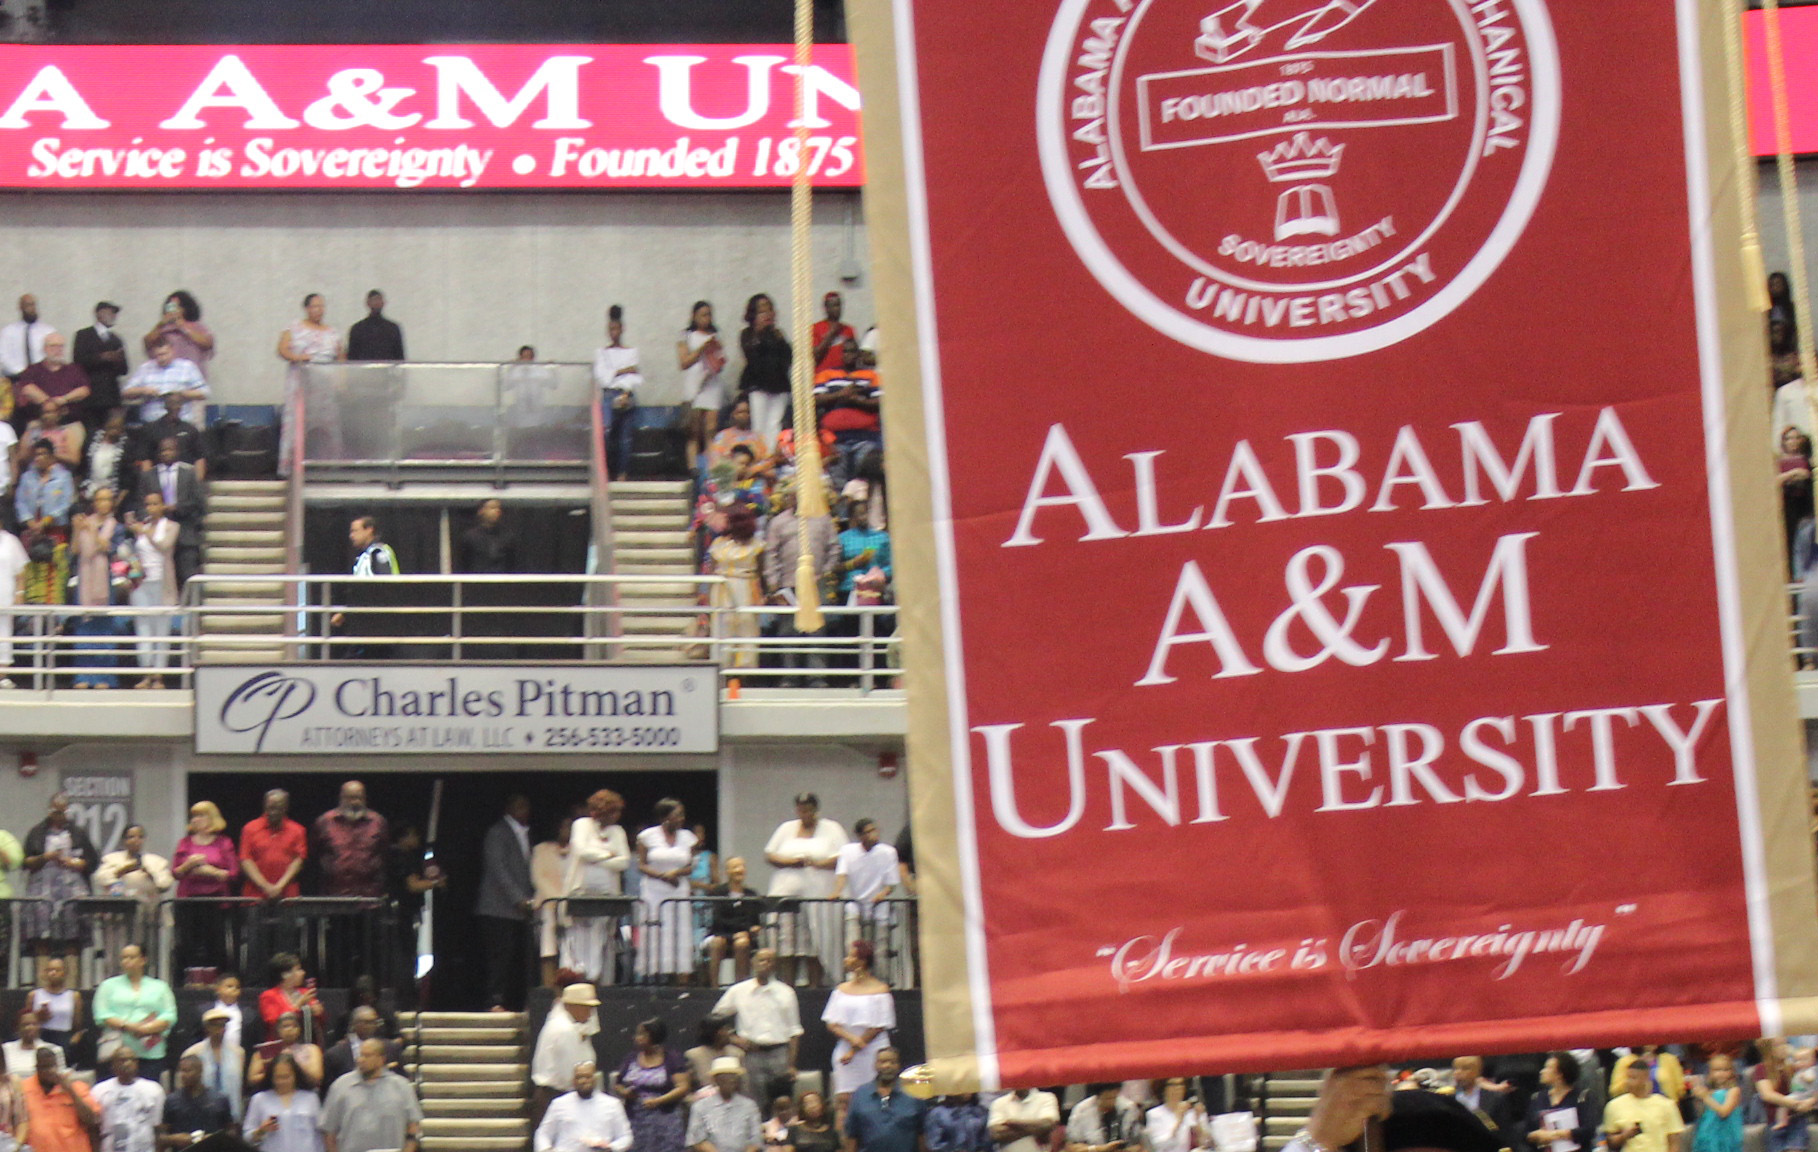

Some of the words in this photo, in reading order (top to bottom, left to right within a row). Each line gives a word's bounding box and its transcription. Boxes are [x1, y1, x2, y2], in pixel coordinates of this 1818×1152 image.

[158, 54, 594, 132] A&M
[1072, 16, 1127, 190] ALABAMA
[1160, 79, 1305, 124] FOUNDED
[1306, 72, 1436, 105] NORMAL
[1471, 0, 1526, 158] HANICAL
[27, 137, 187, 178] Service
[196, 137, 233, 177] is
[241, 137, 494, 188] Sovereignty
[548, 136, 740, 178] Founded
[752, 136, 857, 178] 1875
[1216, 215, 1398, 268] SOVEREIGNTY
[1184, 251, 1439, 328] UNIVERSITY
[1001, 406, 1661, 548] ALABAMA
[1133, 531, 1550, 687] A&M
[335, 678, 504, 717] Charles
[515, 679, 677, 717] Pitman
[301, 726, 402, 748] ATTORNEYS
[405, 726, 428, 748] AT
[481, 726, 514, 748] LLC
[544, 726, 682, 747] 256-533-5000
[970, 698, 1725, 839] UNIVERSITY
[63, 775, 131, 798] SECTION
[1290, 937, 1329, 970] is
